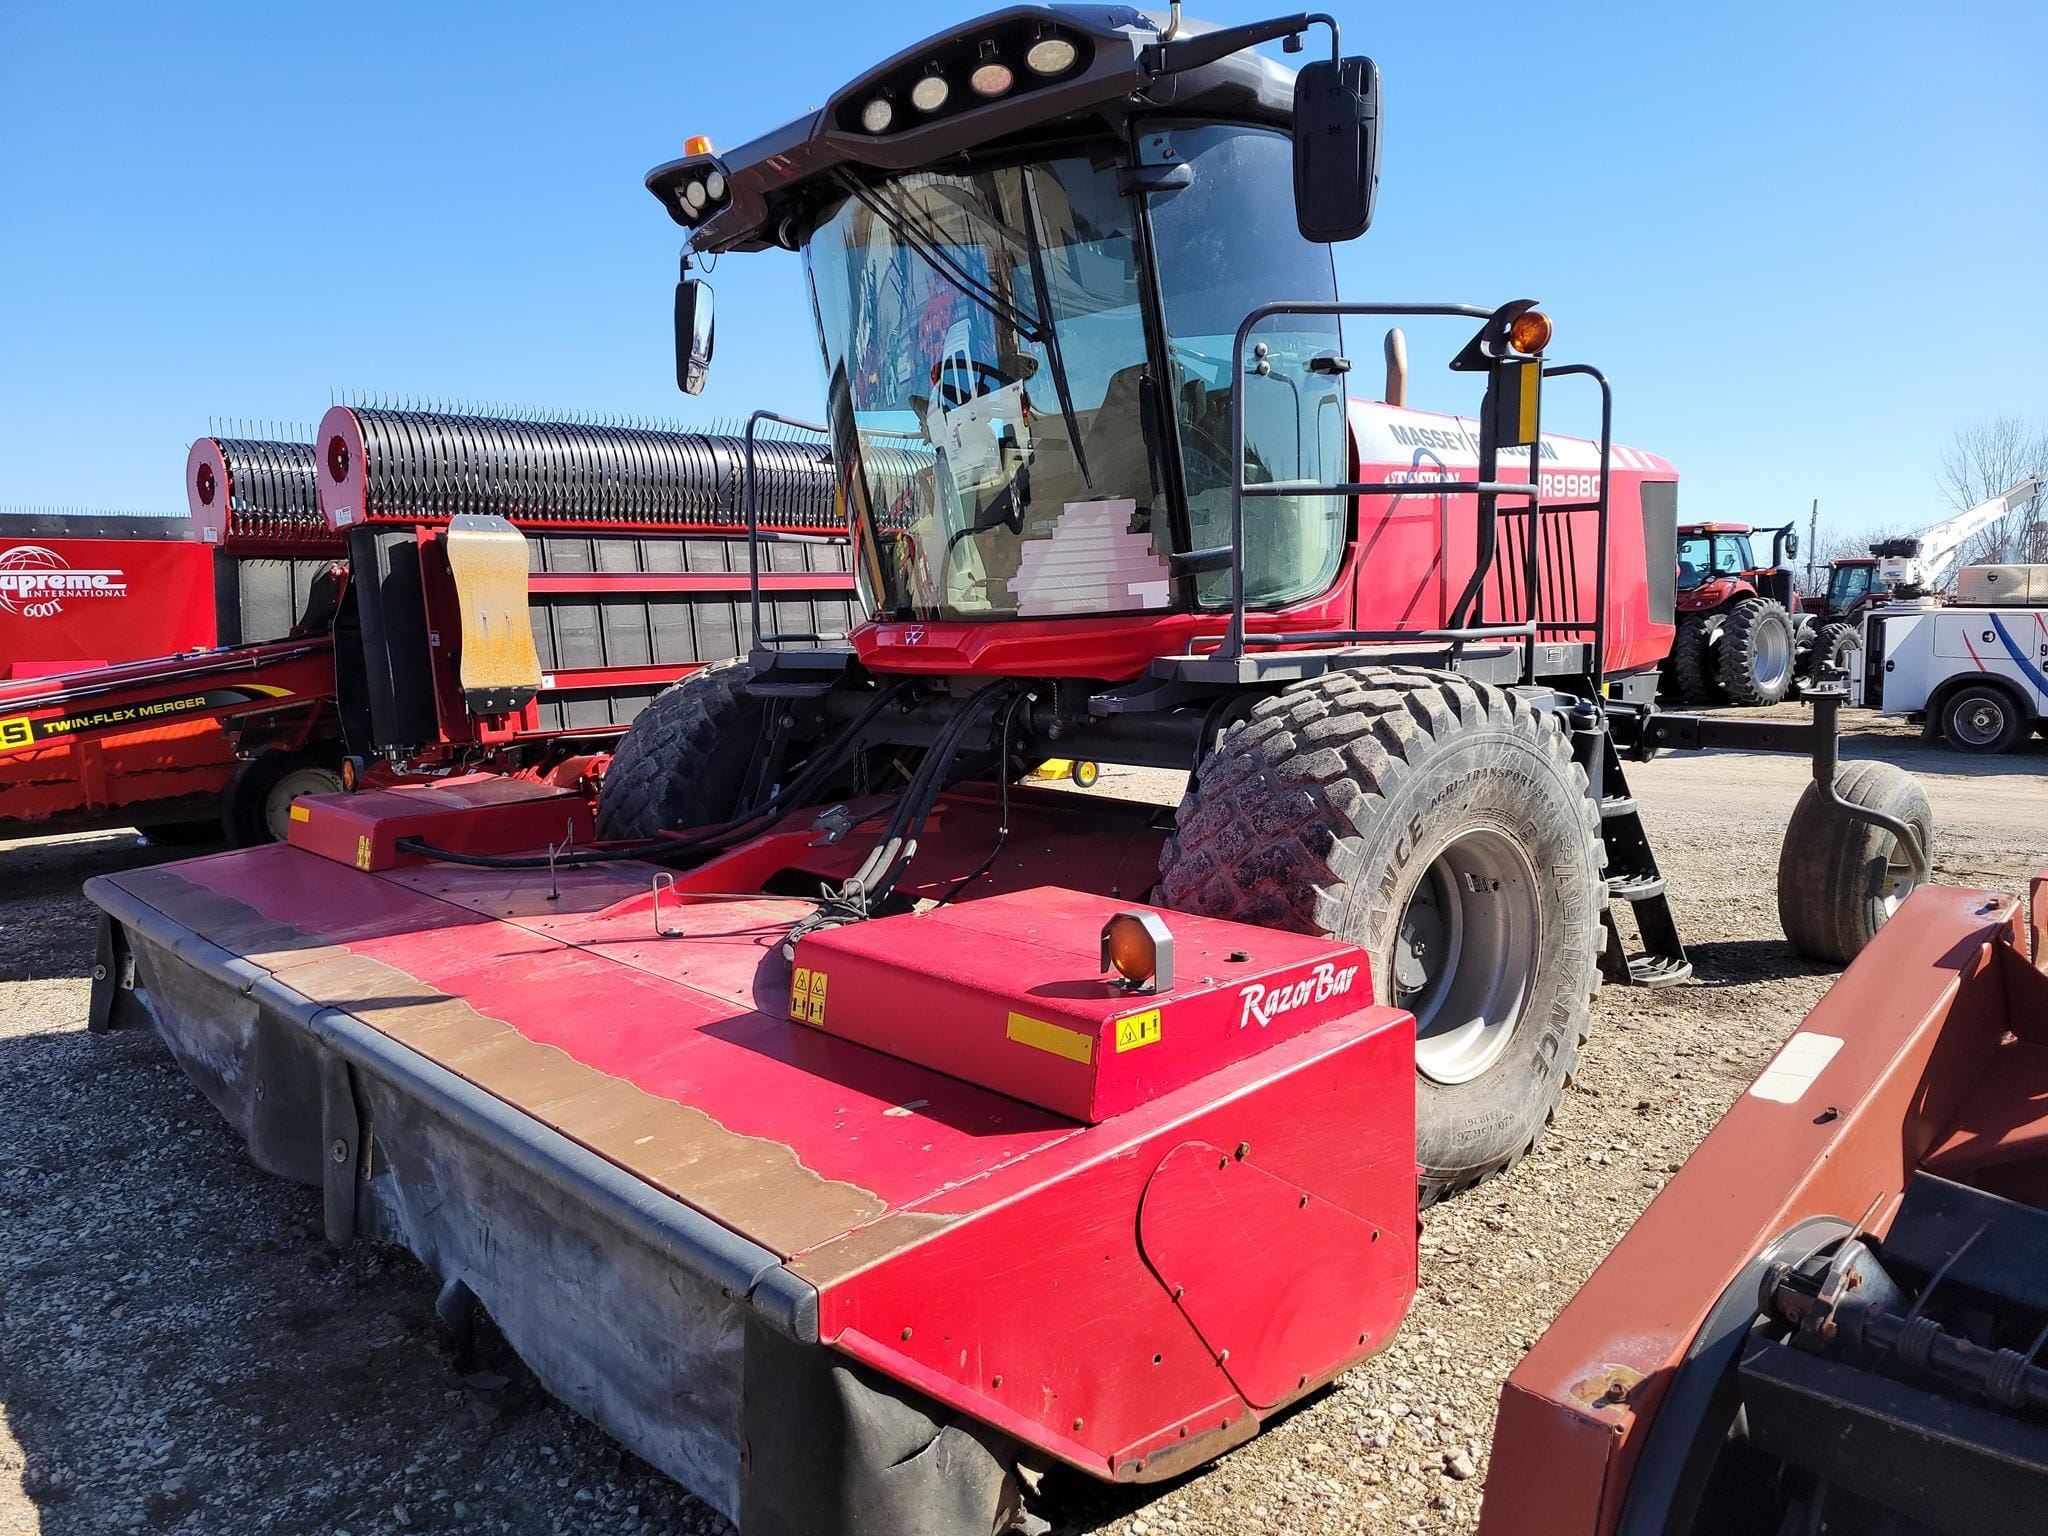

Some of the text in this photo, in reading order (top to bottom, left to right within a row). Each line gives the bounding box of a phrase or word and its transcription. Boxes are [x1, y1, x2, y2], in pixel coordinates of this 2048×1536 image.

[1389, 424, 1467, 451] MASSEY
[23, 598, 64, 617] 600T
[28, 589, 127, 598] INTERNATIONAL
[43, 709, 136, 733] TWIN-FLEX
[139, 697, 206, 717] MERGER
[1430, 767, 1535, 809] AGRI-TRANSPORT
[1239, 962, 1359, 1029] RazorBar
